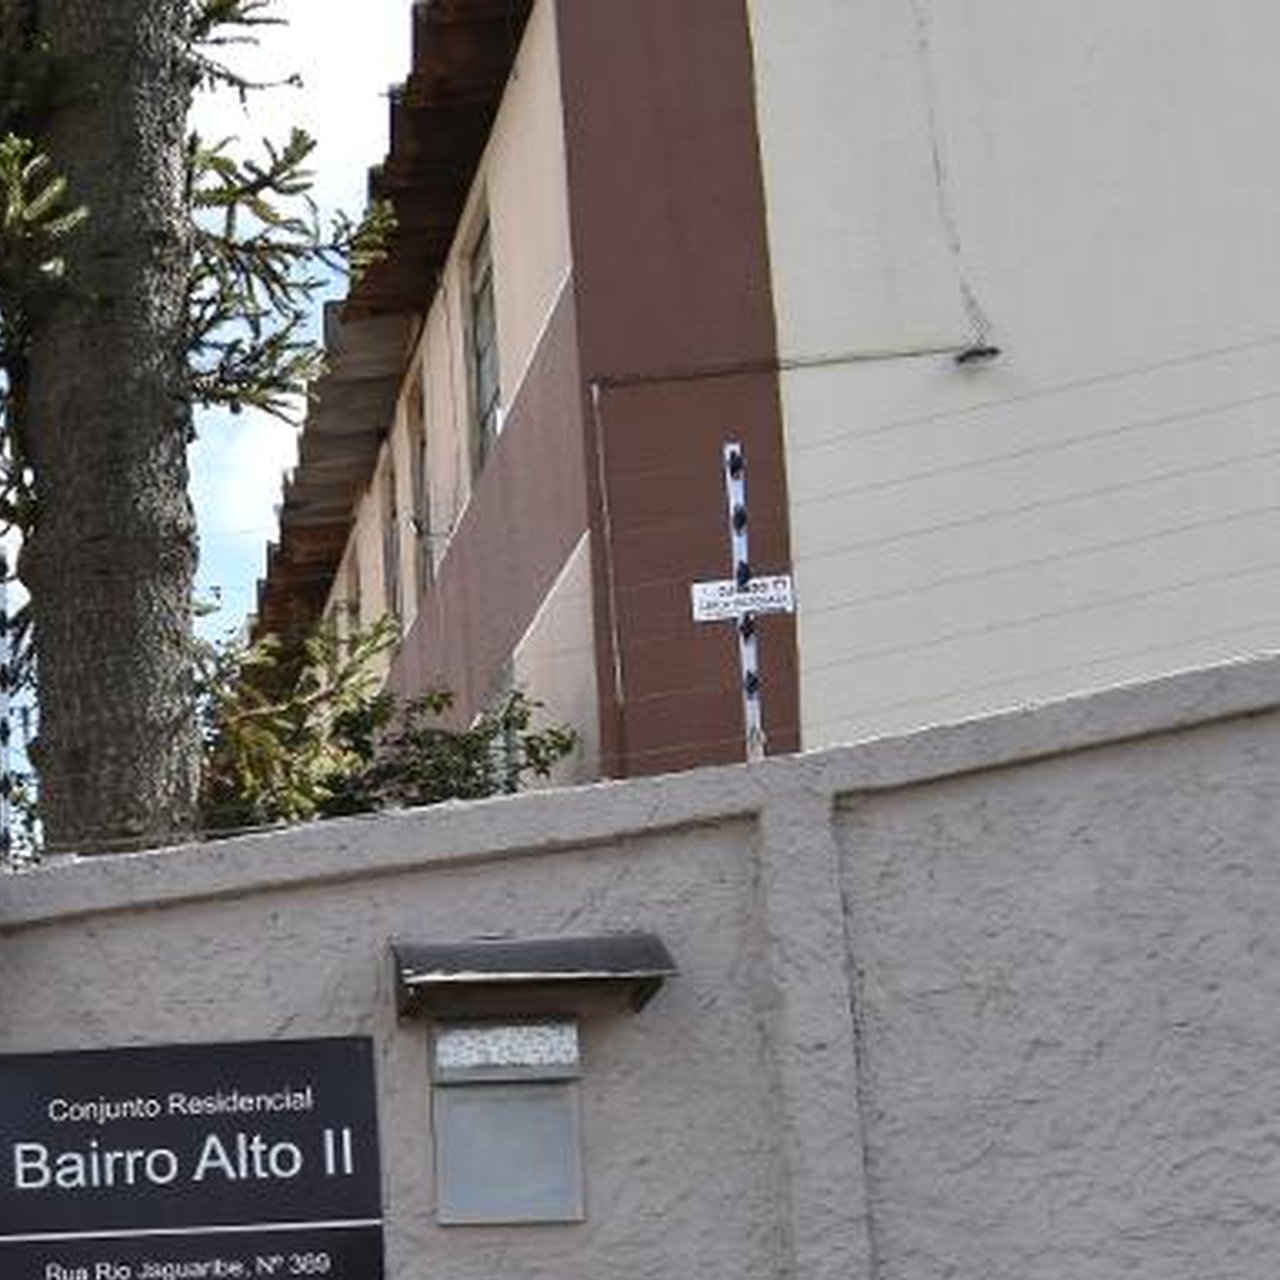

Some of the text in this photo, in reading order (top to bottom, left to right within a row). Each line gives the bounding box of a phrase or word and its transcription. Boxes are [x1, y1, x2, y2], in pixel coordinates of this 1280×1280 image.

[47, 1085, 314, 1125] Conjunto Residencial
[12, 1128, 354, 1189] Bairro Alto II
